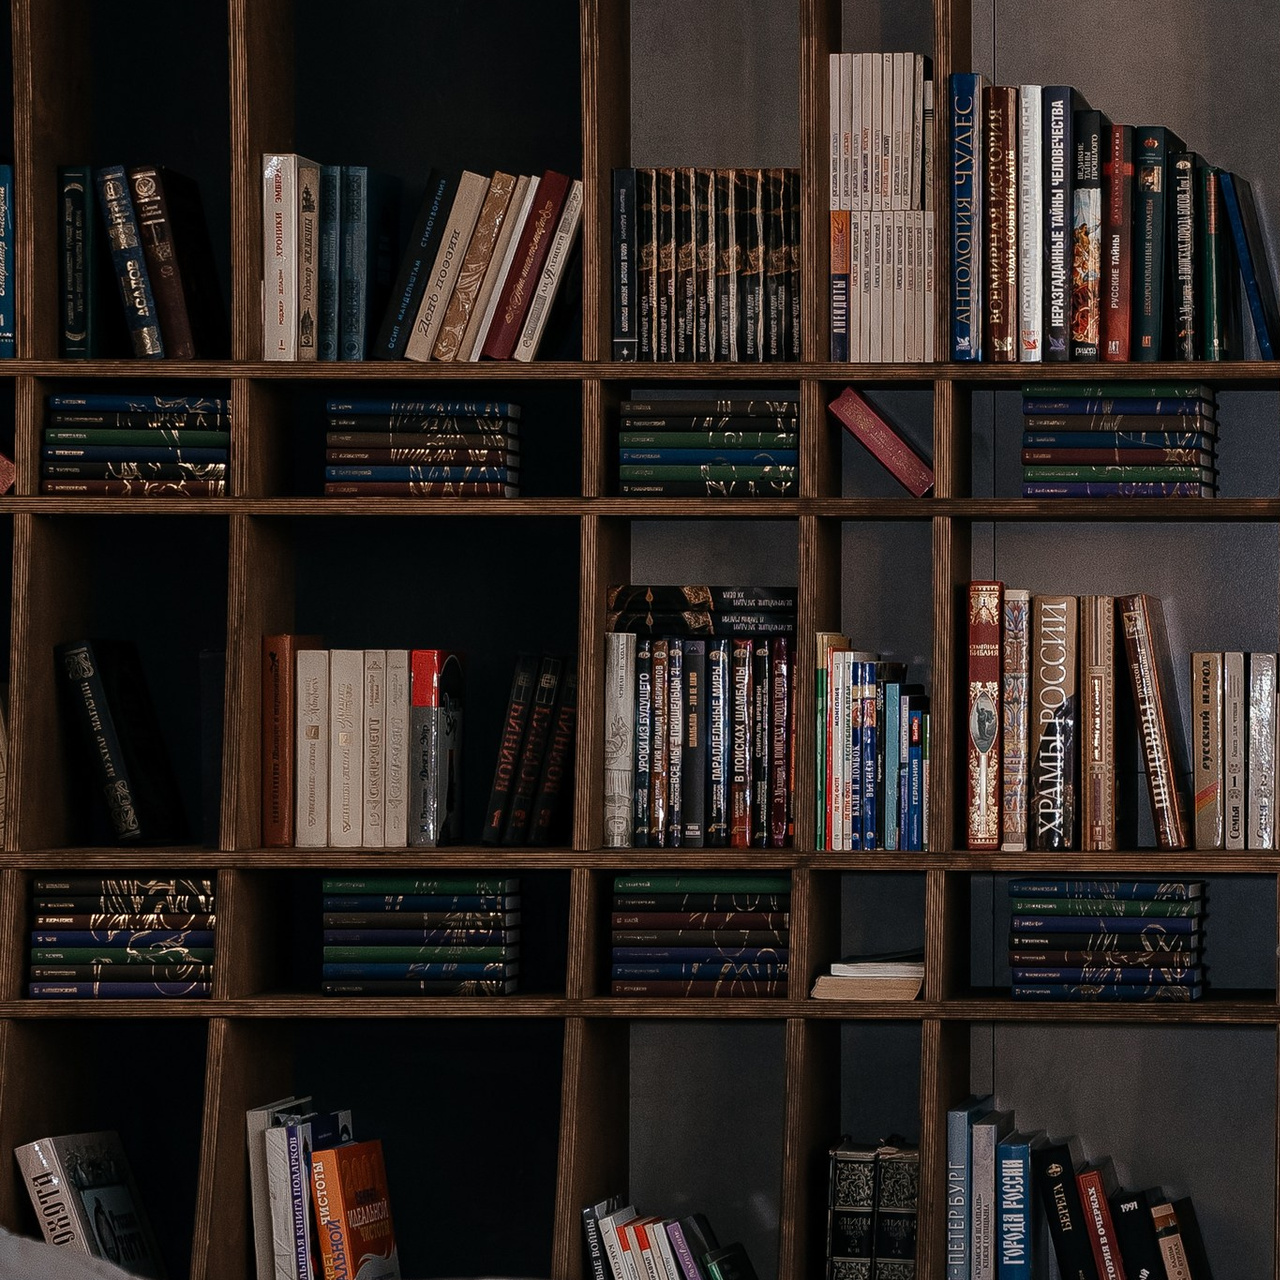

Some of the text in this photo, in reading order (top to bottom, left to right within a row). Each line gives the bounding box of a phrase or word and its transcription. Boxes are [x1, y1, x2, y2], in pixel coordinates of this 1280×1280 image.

[275, 212, 283, 257] ХРОНИКИ
[954, 96, 974, 324] АНТОЛОГИЯ ЧУДЕС
[989, 108, 1003, 323] ВСЕМИРНАЯ ИСТОРИЯ
[1050, 100, 1064, 326] НЕРАЗГАДАННЫЕ ТАЙНЫ ЧЕЛОВЕЧЕСТВА
[303, 218, 313, 301] Роджер ЖЕЛЯЗНЫ
[387, 179, 446, 349] ОСИП МАНДЕЛЬШТАМ СТИХОТВОРЕНИЯ
[417, 229, 461, 337] День поэзии
[1110, 235, 1120, 308] РУССКИЕ ТАЙНЫ
[1143, 199, 1153, 316] НЕКОРОНОВАННЫЕ КОРОЛЕВЫ
[126, 259, 148, 316] АСАДОВ
[832, 281, 846, 333] АНЕКДОТЫ
[969, 649, 999, 657] БИБЛИЯ
[654, 665, 664, 708] ЛАБИРИНТОВ
[735, 667, 745, 721] ШАМБАЛЫ
[638, 673, 650, 772] УРОКИ ИЗ БУДУЩЕГО
[654, 717, 664, 748] ПИРАМИД
[712, 666, 722, 780] ПАРАЛЛЕЛЬНЫЕ МИРЫ
[1037, 601, 1067, 835] ХРАМЫ РОССИИ
[654, 750, 664, 772] МАГИЯ
[671, 748, 680, 763] МЫ
[671, 765, 680, 783] ВСЕ
[735, 725, 745, 772] ПОИСКАХ
[852, 745, 860, 780] ЛОМБОК
[1139, 701, 1171, 809] ШЕДЕВРЫ
[852, 793, 860, 816] БАЛИ
[1229, 806, 1241, 839] Семья
[289, 1136, 303, 1193] ПОДАРКОВ
[293, 1195, 306, 1237] КНИГА
[312, 1161, 331, 1226] ЧИСТОТЫ
[347, 1198, 390, 1229] ИДЕАЛЬНОЙ
[1002, 1159, 1025, 1265] ГОРОДА РОССИИ
[1052, 1182, 1073, 1232] БЕРЕГА
[1087, 1187, 1106, 1235] ОЧЕРКАХ
[1120, 1201, 1139, 1212] 1991
[359, 1220, 391, 1242] ЧИСТОТЫ
[587, 1219, 601, 1256] ВОЙНЫ
